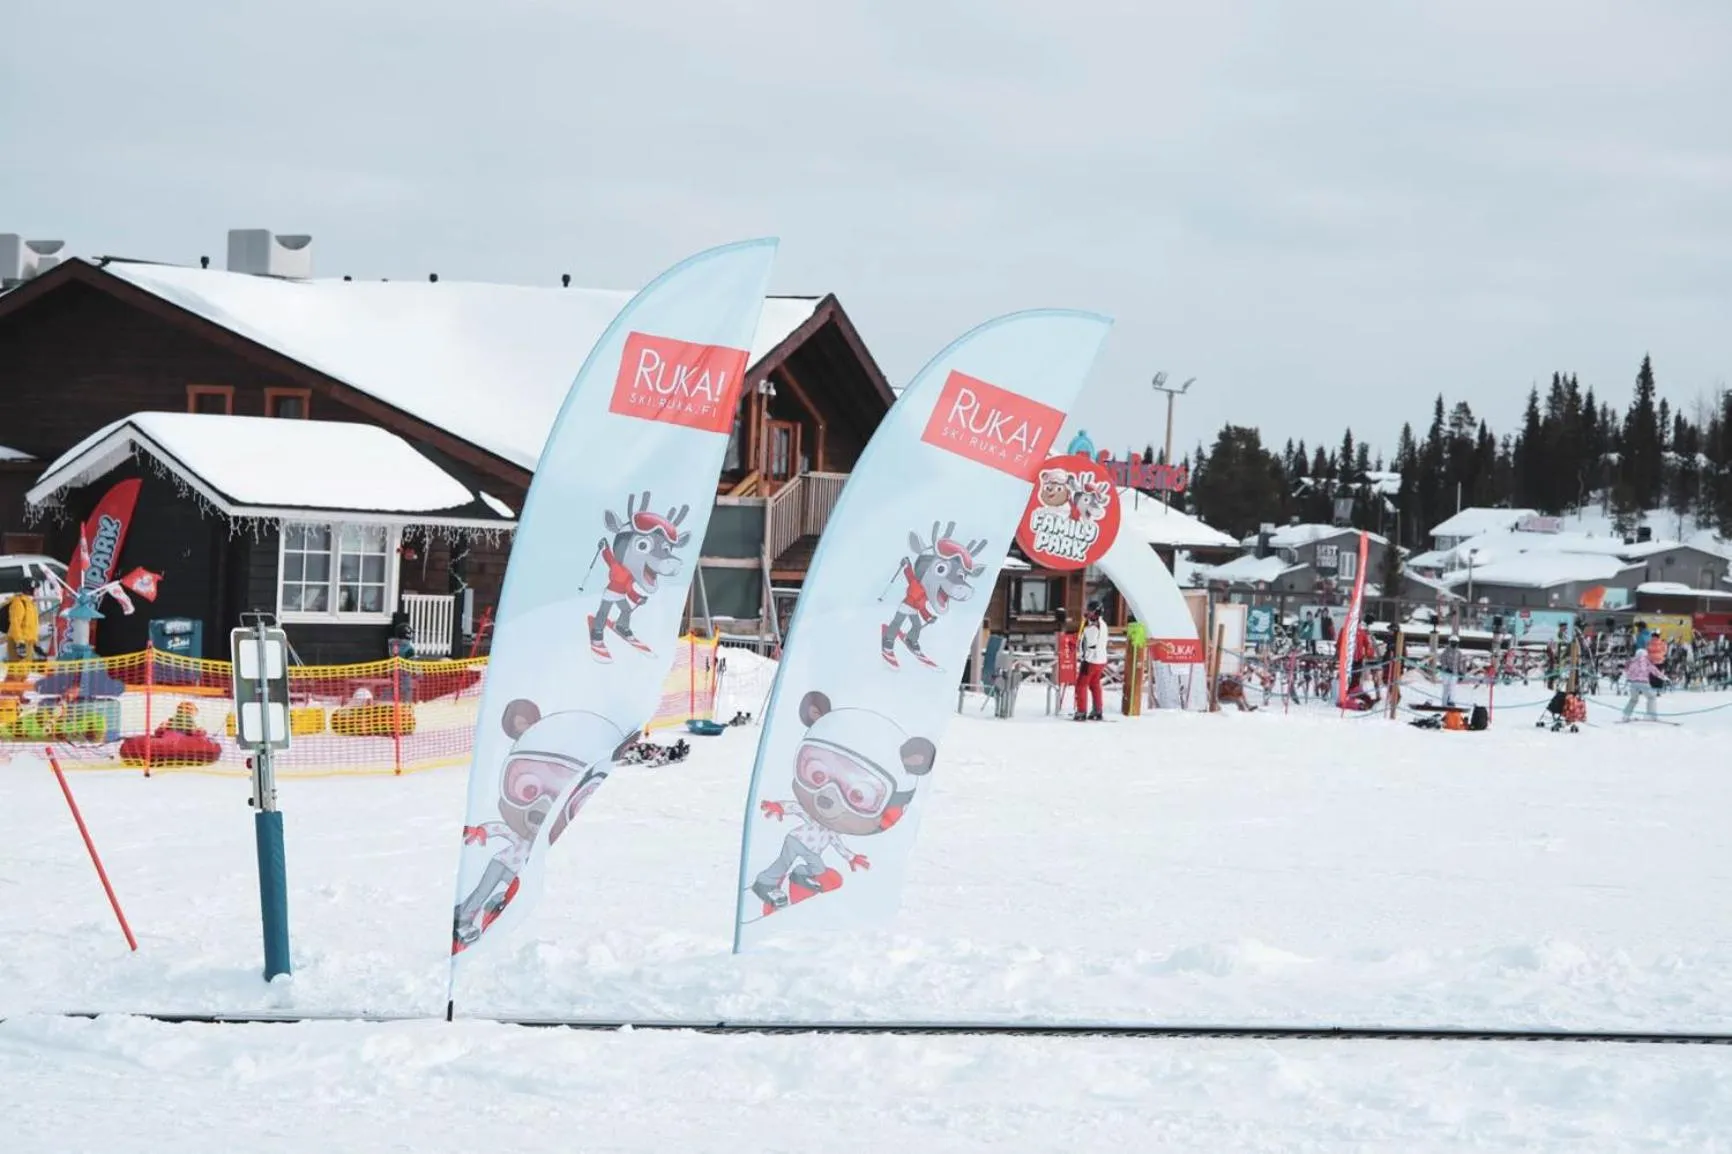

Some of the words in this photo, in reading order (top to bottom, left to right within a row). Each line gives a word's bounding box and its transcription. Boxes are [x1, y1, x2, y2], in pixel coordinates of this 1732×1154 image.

[634, 348, 726, 403] RUKA!
[947, 387, 1043, 454] RUKA!
[84, 515, 121, 586] PARK
[1032, 513, 1097, 543] FAMILY
[1036, 534, 1088, 560] PARK
